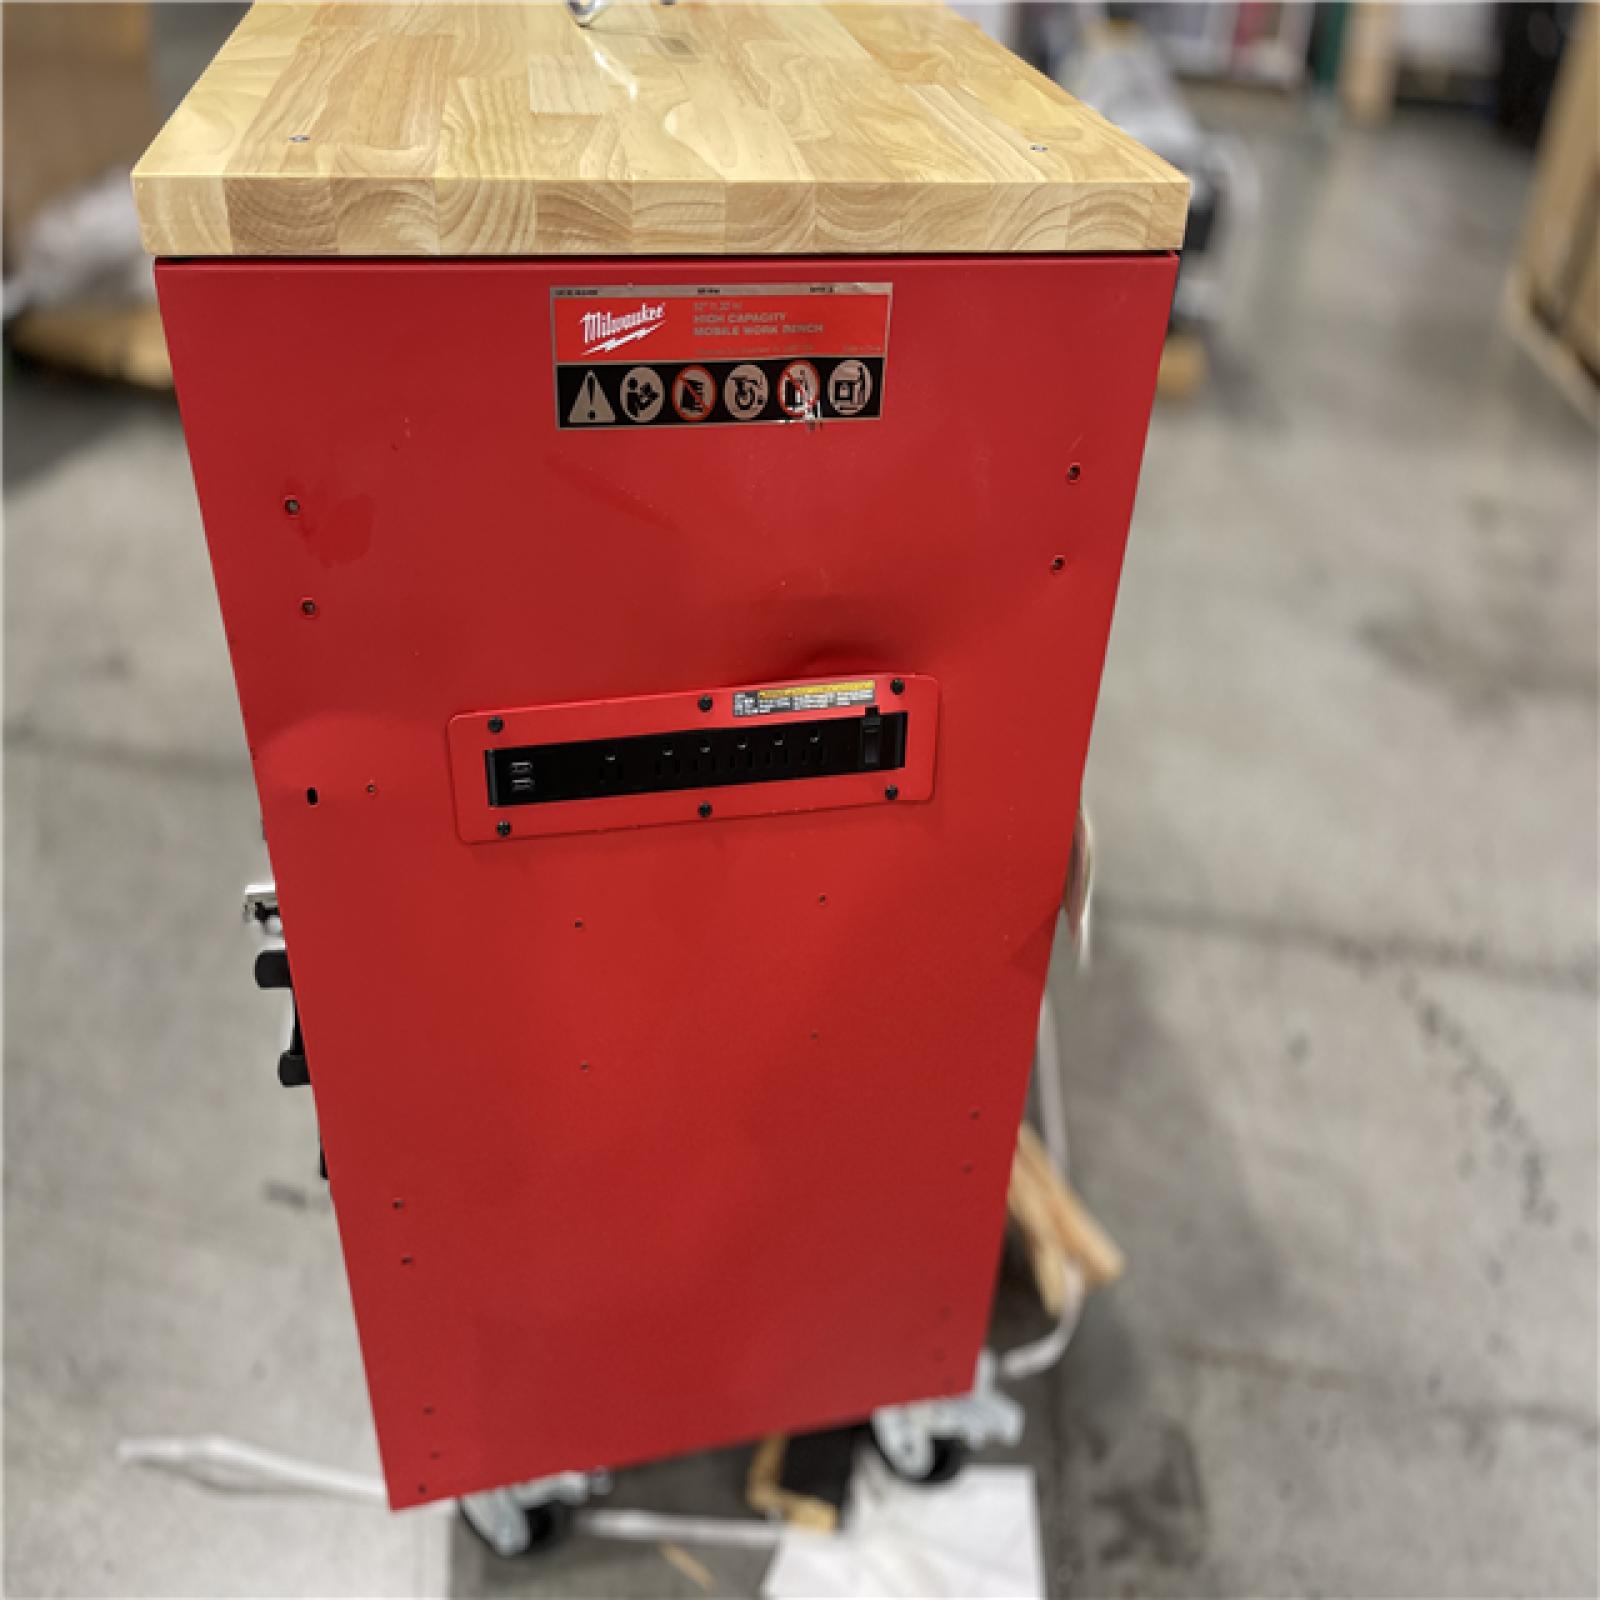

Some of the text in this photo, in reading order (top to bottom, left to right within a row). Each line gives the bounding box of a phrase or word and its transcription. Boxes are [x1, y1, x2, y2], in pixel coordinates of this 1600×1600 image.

[581, 302, 665, 344] Milwaukee
[693, 312, 786, 323] HIGH CAPACITY
[693, 324, 824, 336] MOBILE WORK BENCH
